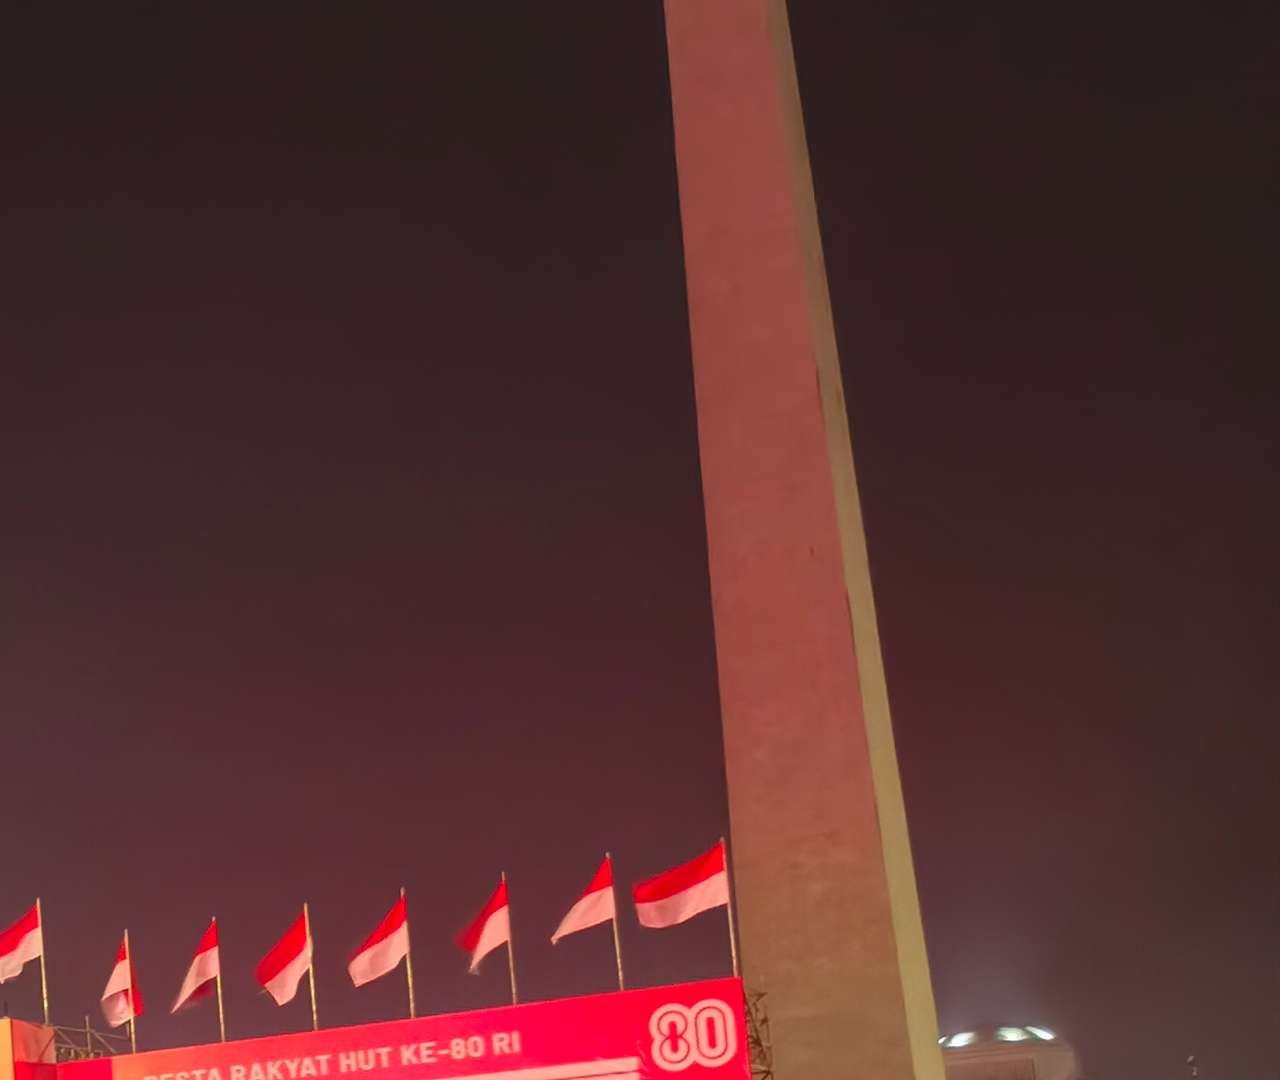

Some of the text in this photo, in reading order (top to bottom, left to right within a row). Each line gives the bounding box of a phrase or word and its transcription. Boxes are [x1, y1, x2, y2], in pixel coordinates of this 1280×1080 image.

[338, 1046, 393, 1073] HUT
[399, 1035, 486, 1066] KE-80
[492, 1030, 522, 1056] RI
[648, 998, 738, 1072] 80
